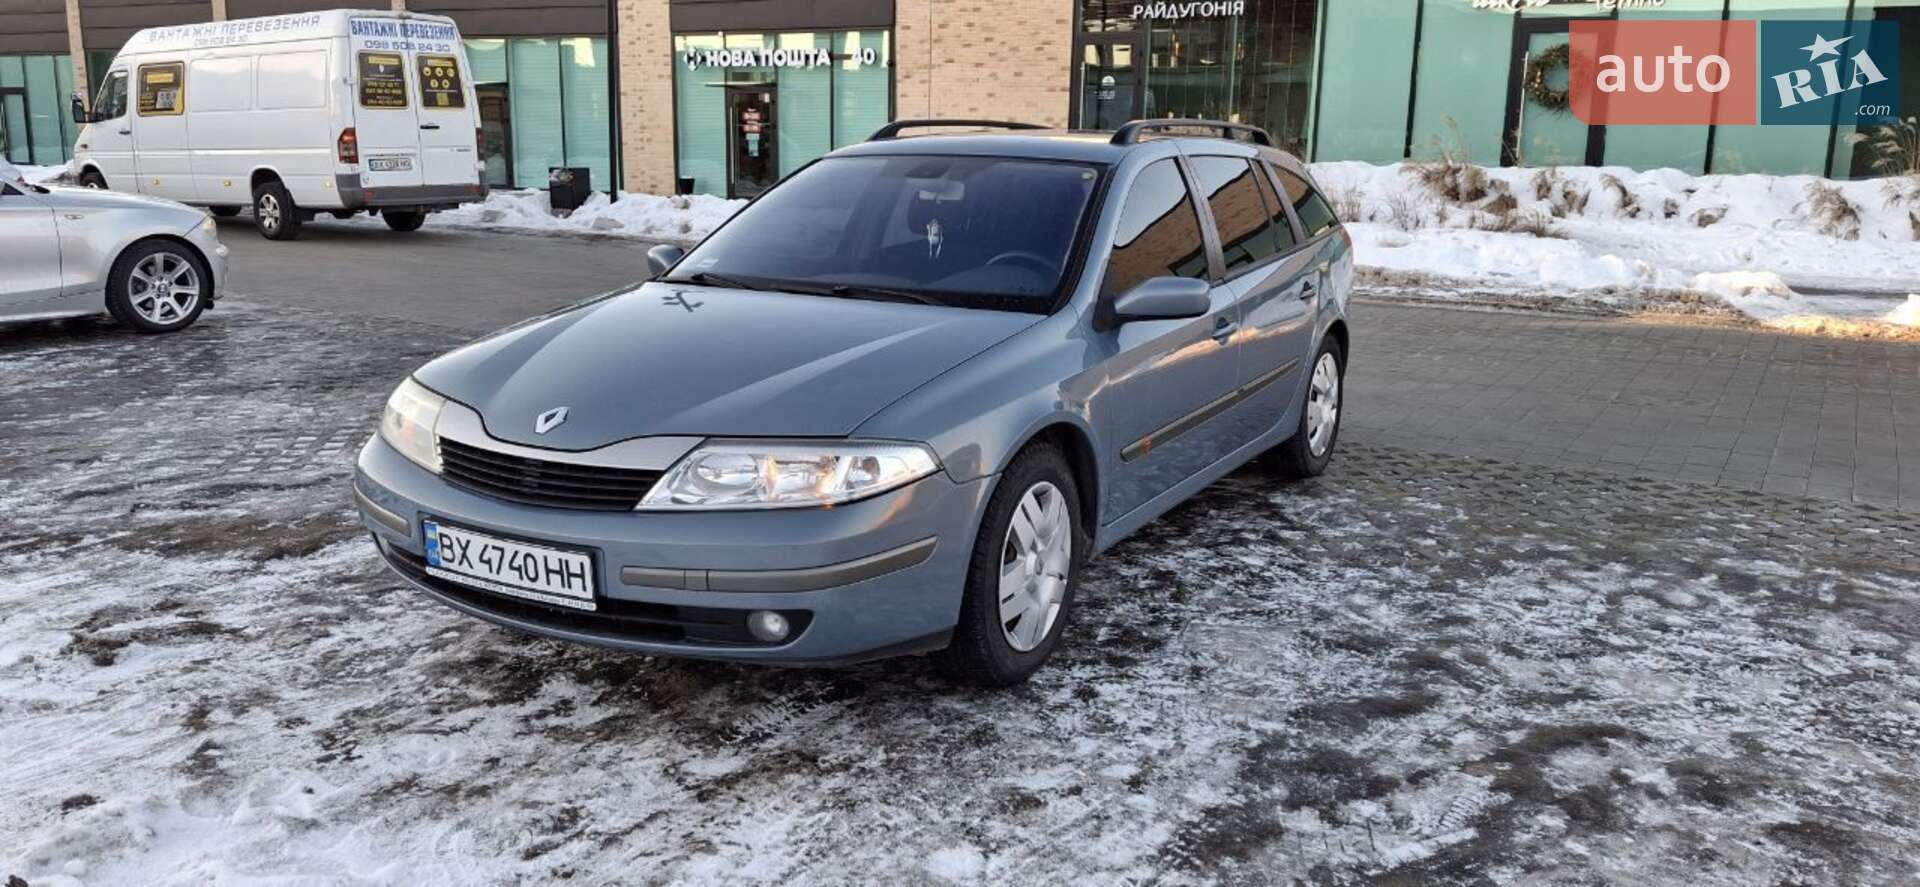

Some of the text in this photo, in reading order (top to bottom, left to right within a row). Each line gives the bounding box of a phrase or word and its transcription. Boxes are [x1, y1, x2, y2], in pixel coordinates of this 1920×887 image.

[1129, 0, 1244, 19] РАЙДУГОНІЯ
[149, 15, 320, 42] ВАНТАЖНІ ПЕРЕВЕЗЕННЯ
[350, 20, 456, 40] ВАНТАЖНІ ПЕРЕВЕЗЕННЯ
[364, 40, 390, 49] 098
[435, 44, 451, 52] 30
[705, 48, 876, 68] НОВА ПОШТА 40
[438, 532, 473, 569] BX
[479, 543, 539, 583] 4740
[543, 555, 587, 592] HH
